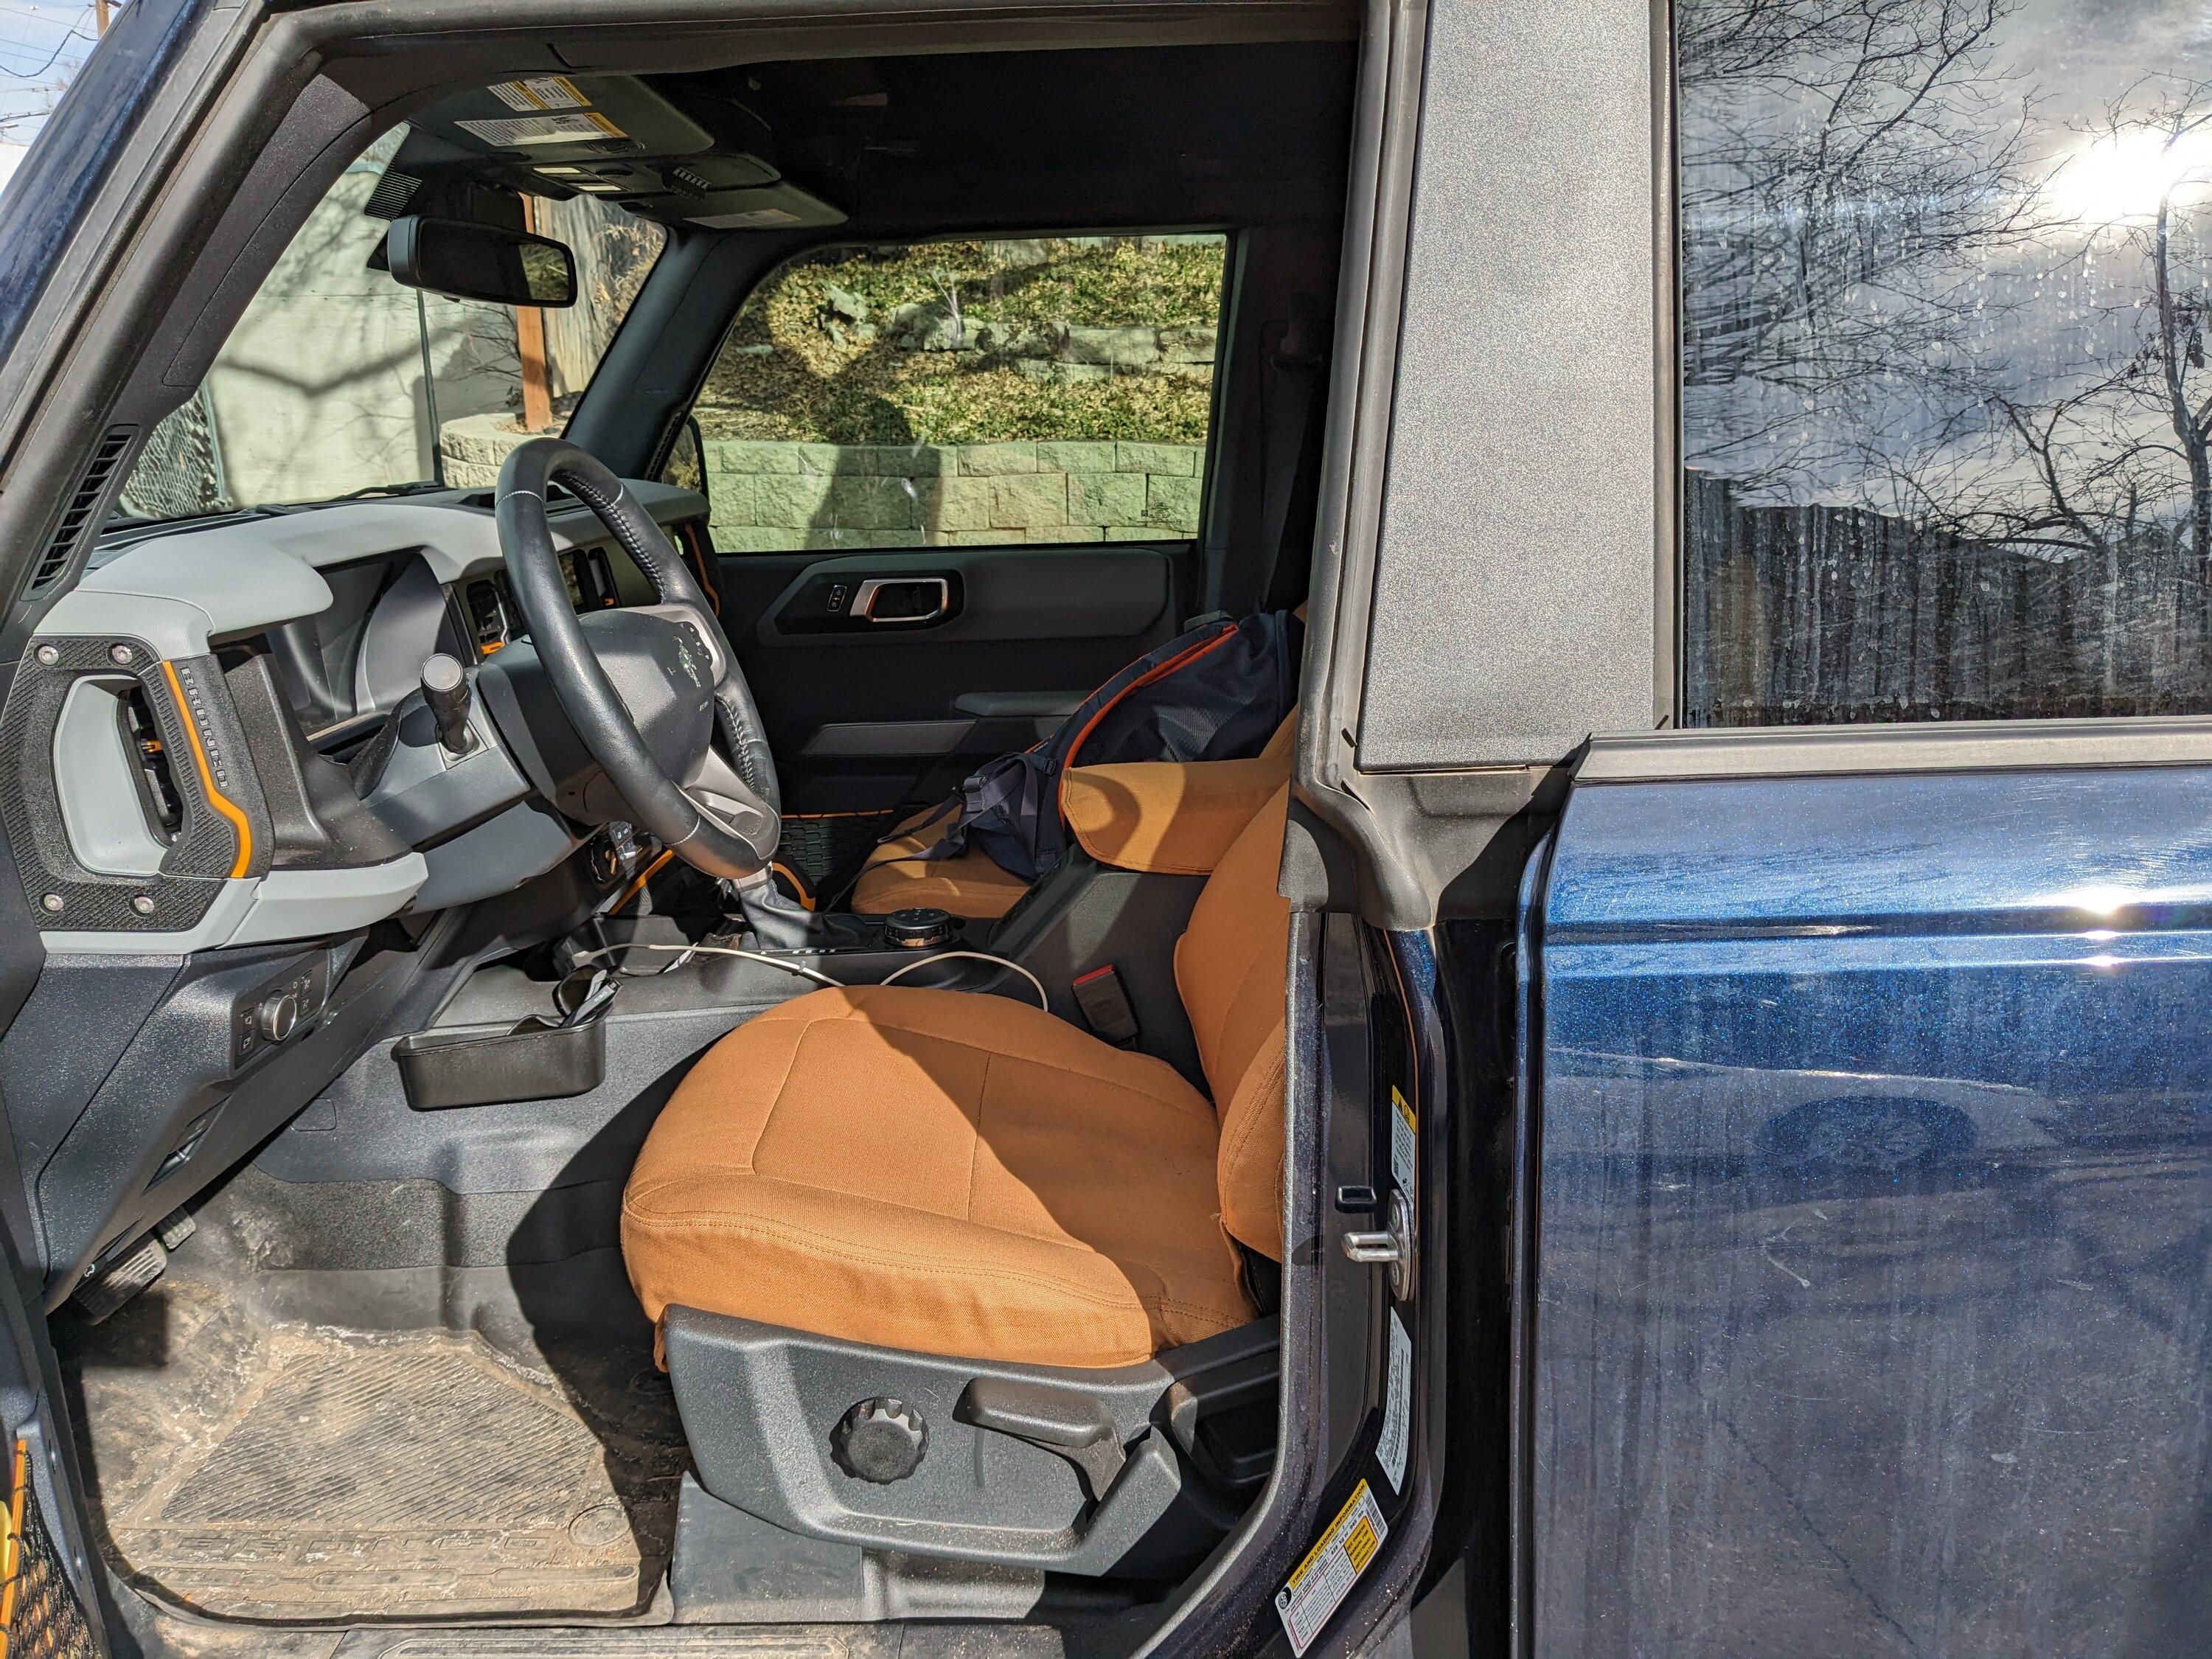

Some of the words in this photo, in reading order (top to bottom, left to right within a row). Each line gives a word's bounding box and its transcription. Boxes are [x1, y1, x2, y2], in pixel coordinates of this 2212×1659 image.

[180, 667, 229, 788] BRONCO
[178, 1535, 550, 1553] BRONCO
[1291, 1568, 1304, 1586] TIRE
[1303, 1554, 1314, 1571] AND
[1313, 1526, 1335, 1556] LOADING
[1335, 1483, 1365, 1528] INFORMATION
